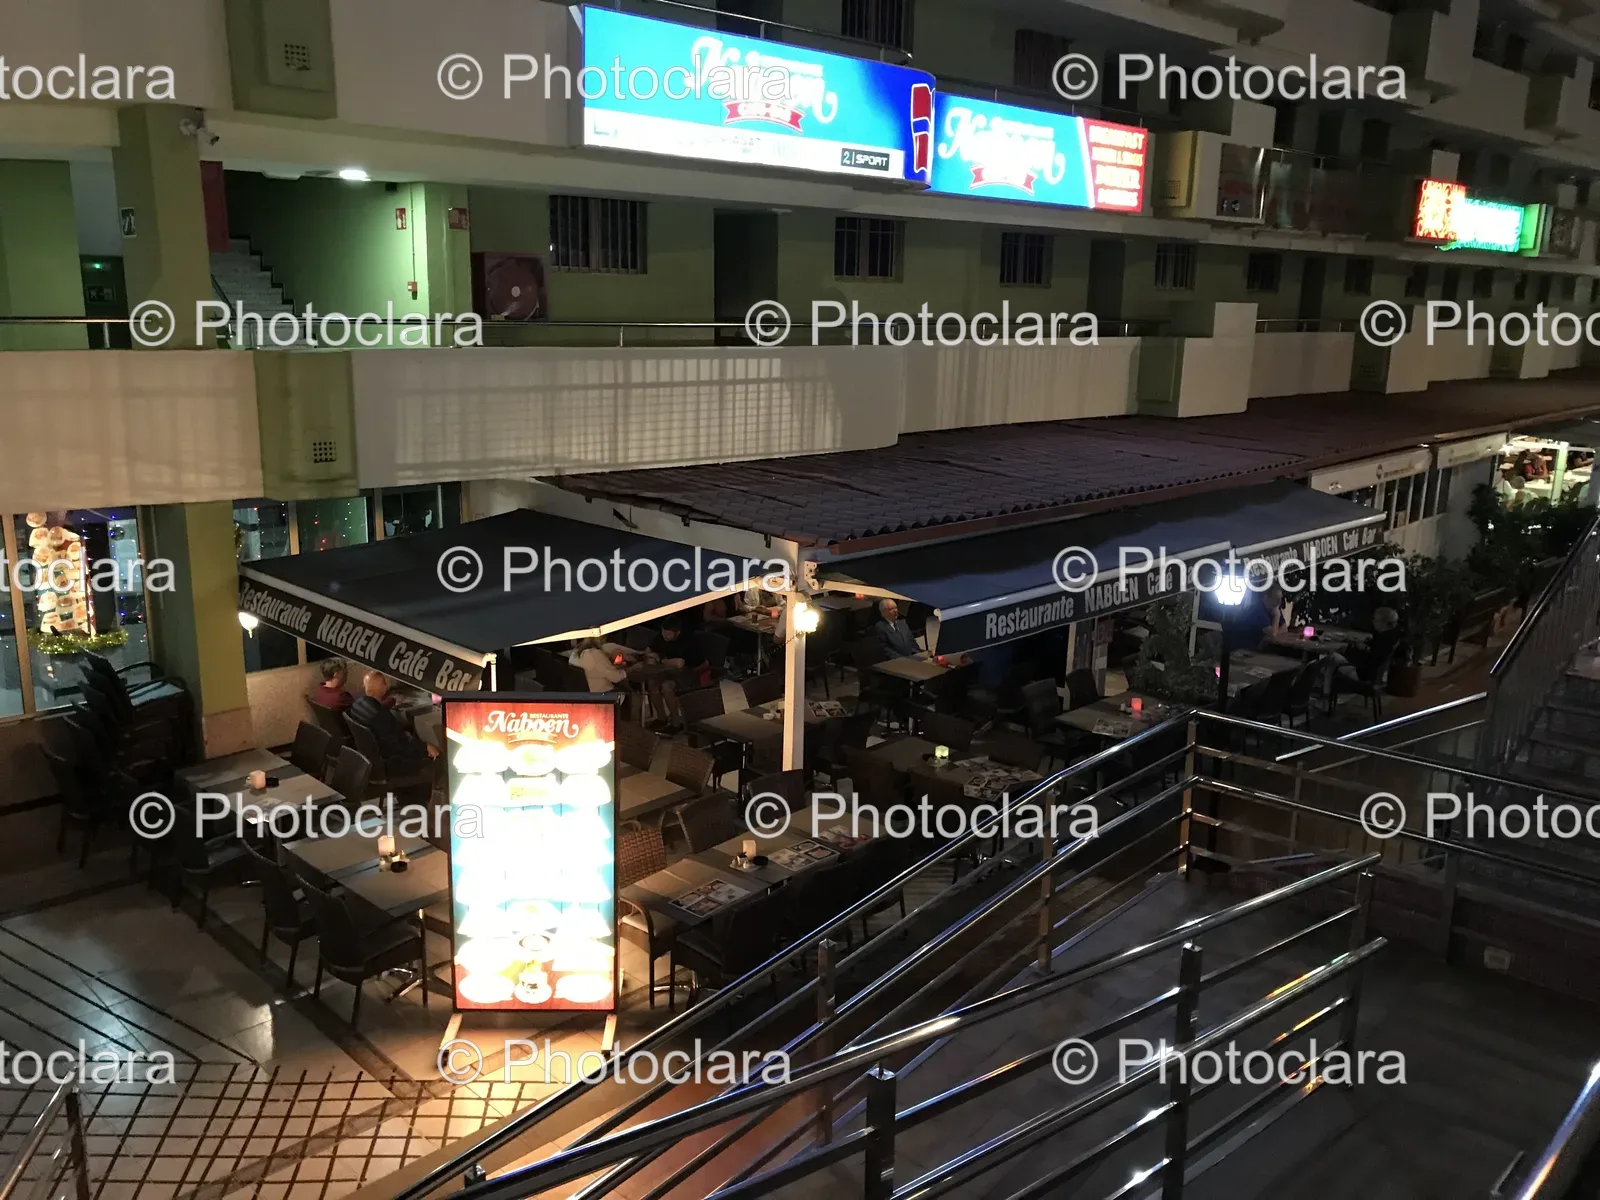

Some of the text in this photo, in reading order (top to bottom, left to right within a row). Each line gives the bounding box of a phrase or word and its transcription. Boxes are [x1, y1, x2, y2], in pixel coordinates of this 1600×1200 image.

[985, 596, 1075, 640] Restaurante
[1084, 575, 1139, 614] NABOEN
[1147, 566, 1173, 596] Caé
[316, 612, 386, 663] NABOEN
[388, 641, 433, 681] Café
[435, 659, 473, 692] Bar
[483, 710, 579, 739] Naboen
